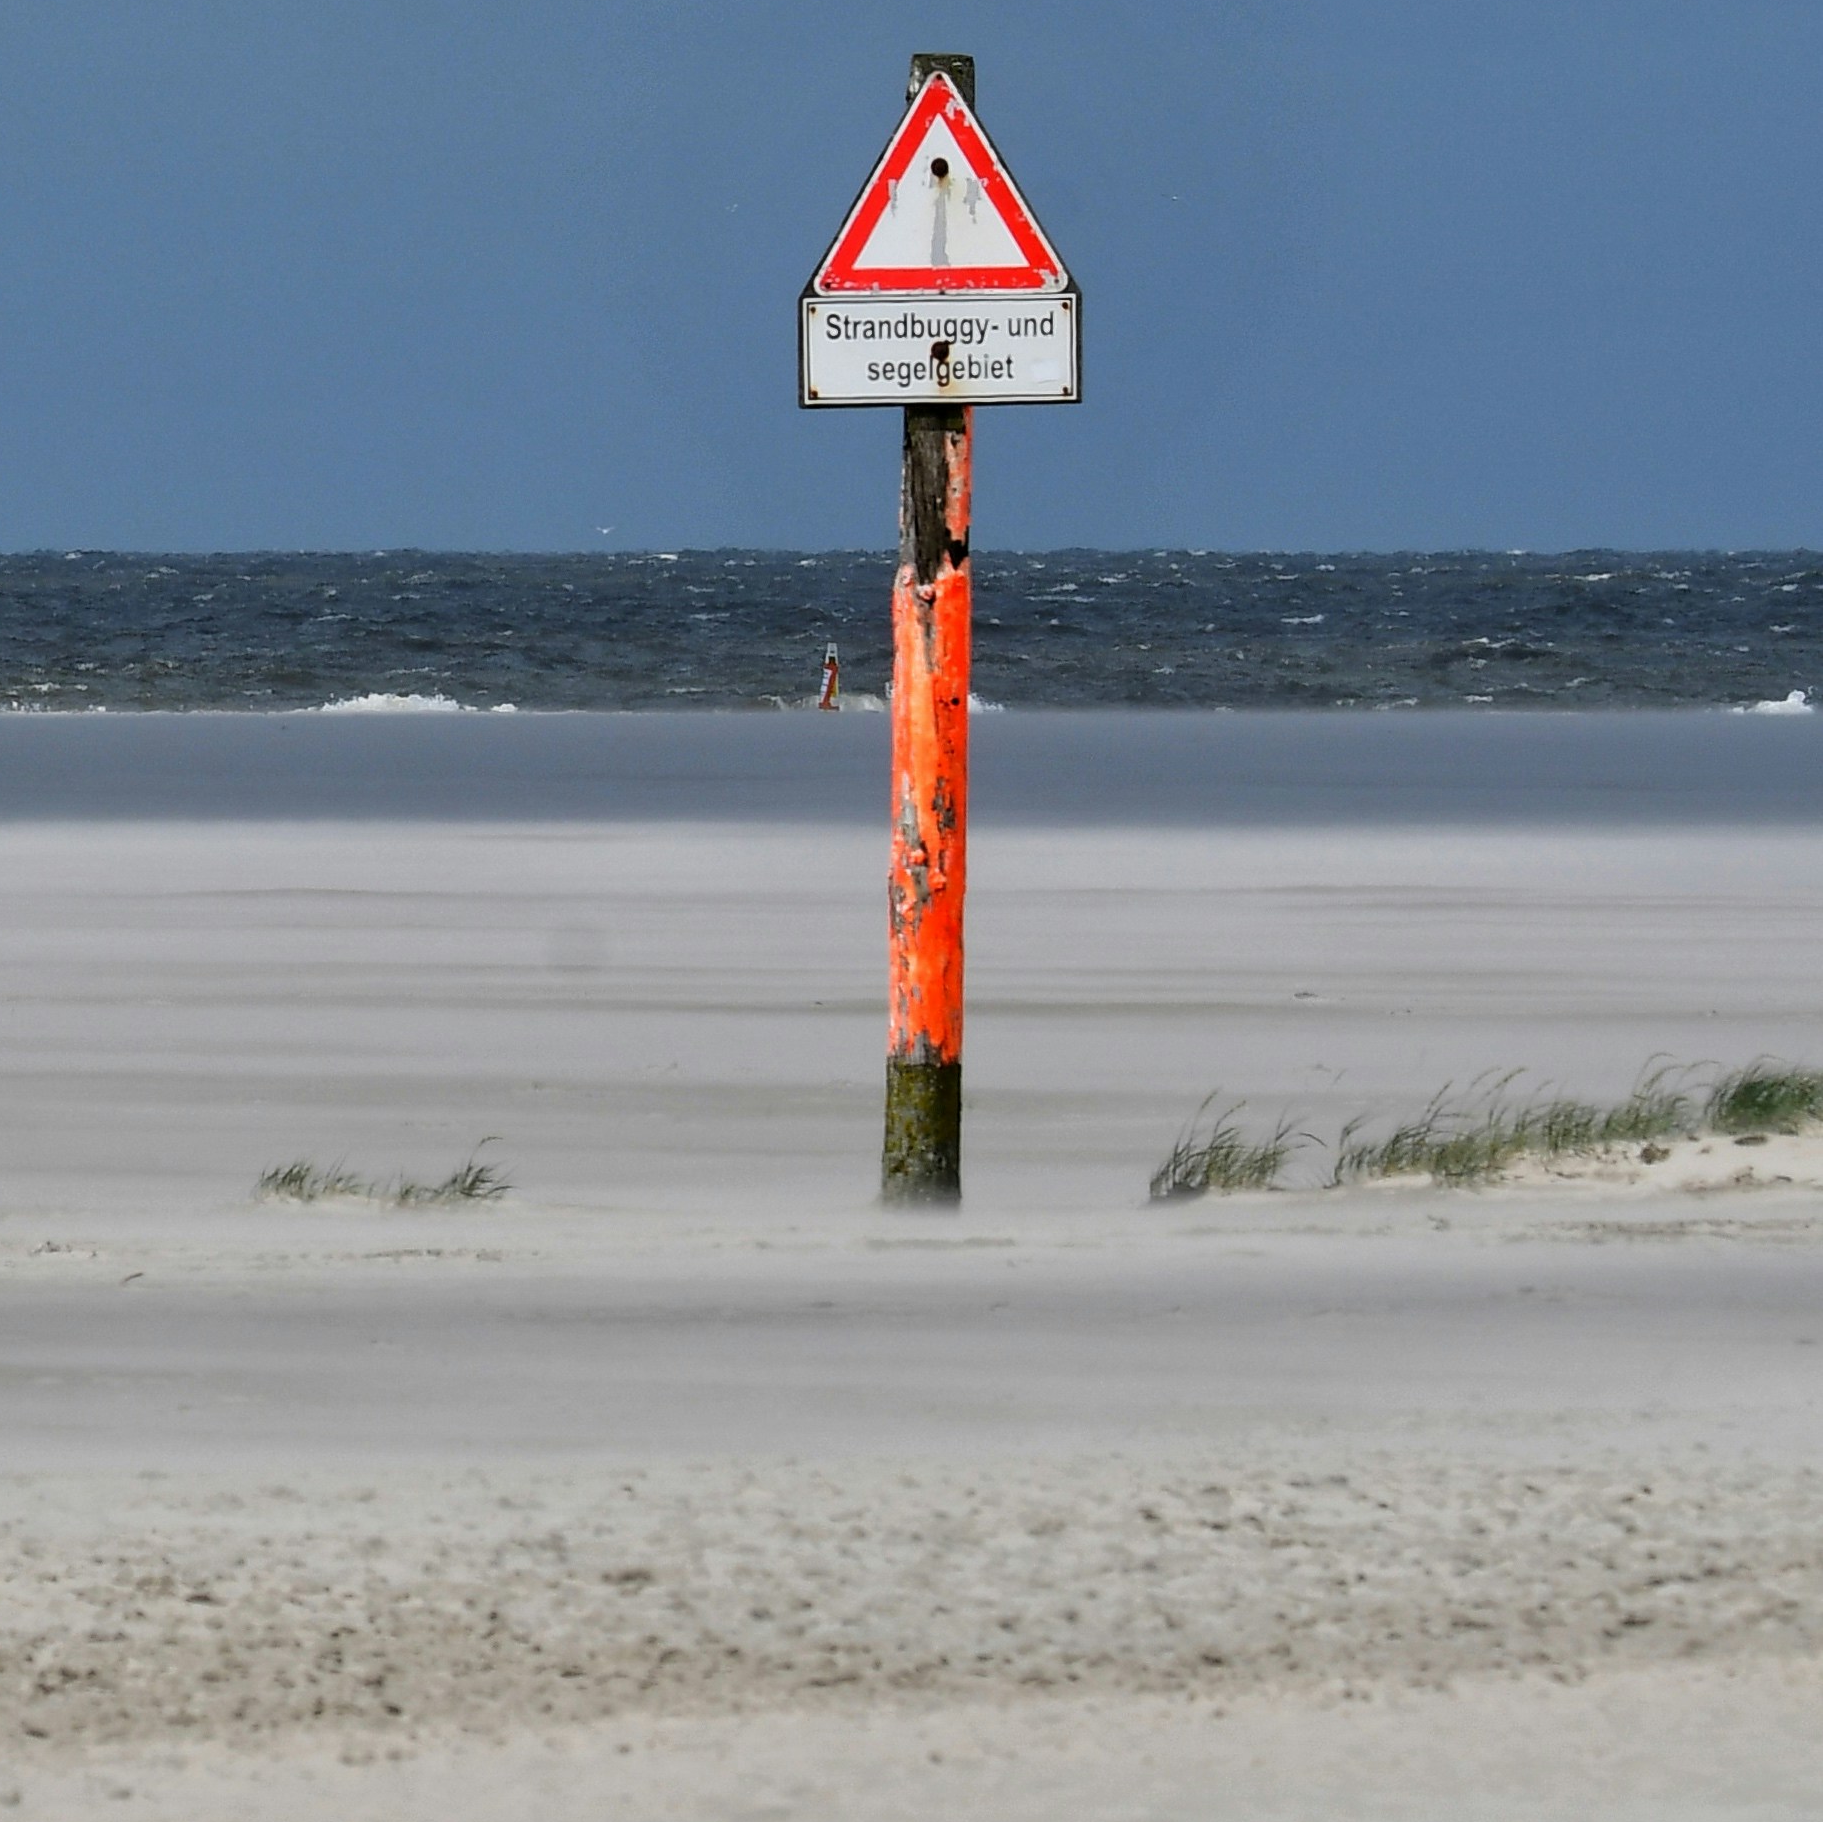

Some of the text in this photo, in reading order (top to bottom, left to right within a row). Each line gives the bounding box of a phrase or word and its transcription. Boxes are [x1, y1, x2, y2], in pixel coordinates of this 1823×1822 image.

[826, 311, 1055, 346] Strandbuggy- und
[867, 354, 1014, 387] segelgebiet
